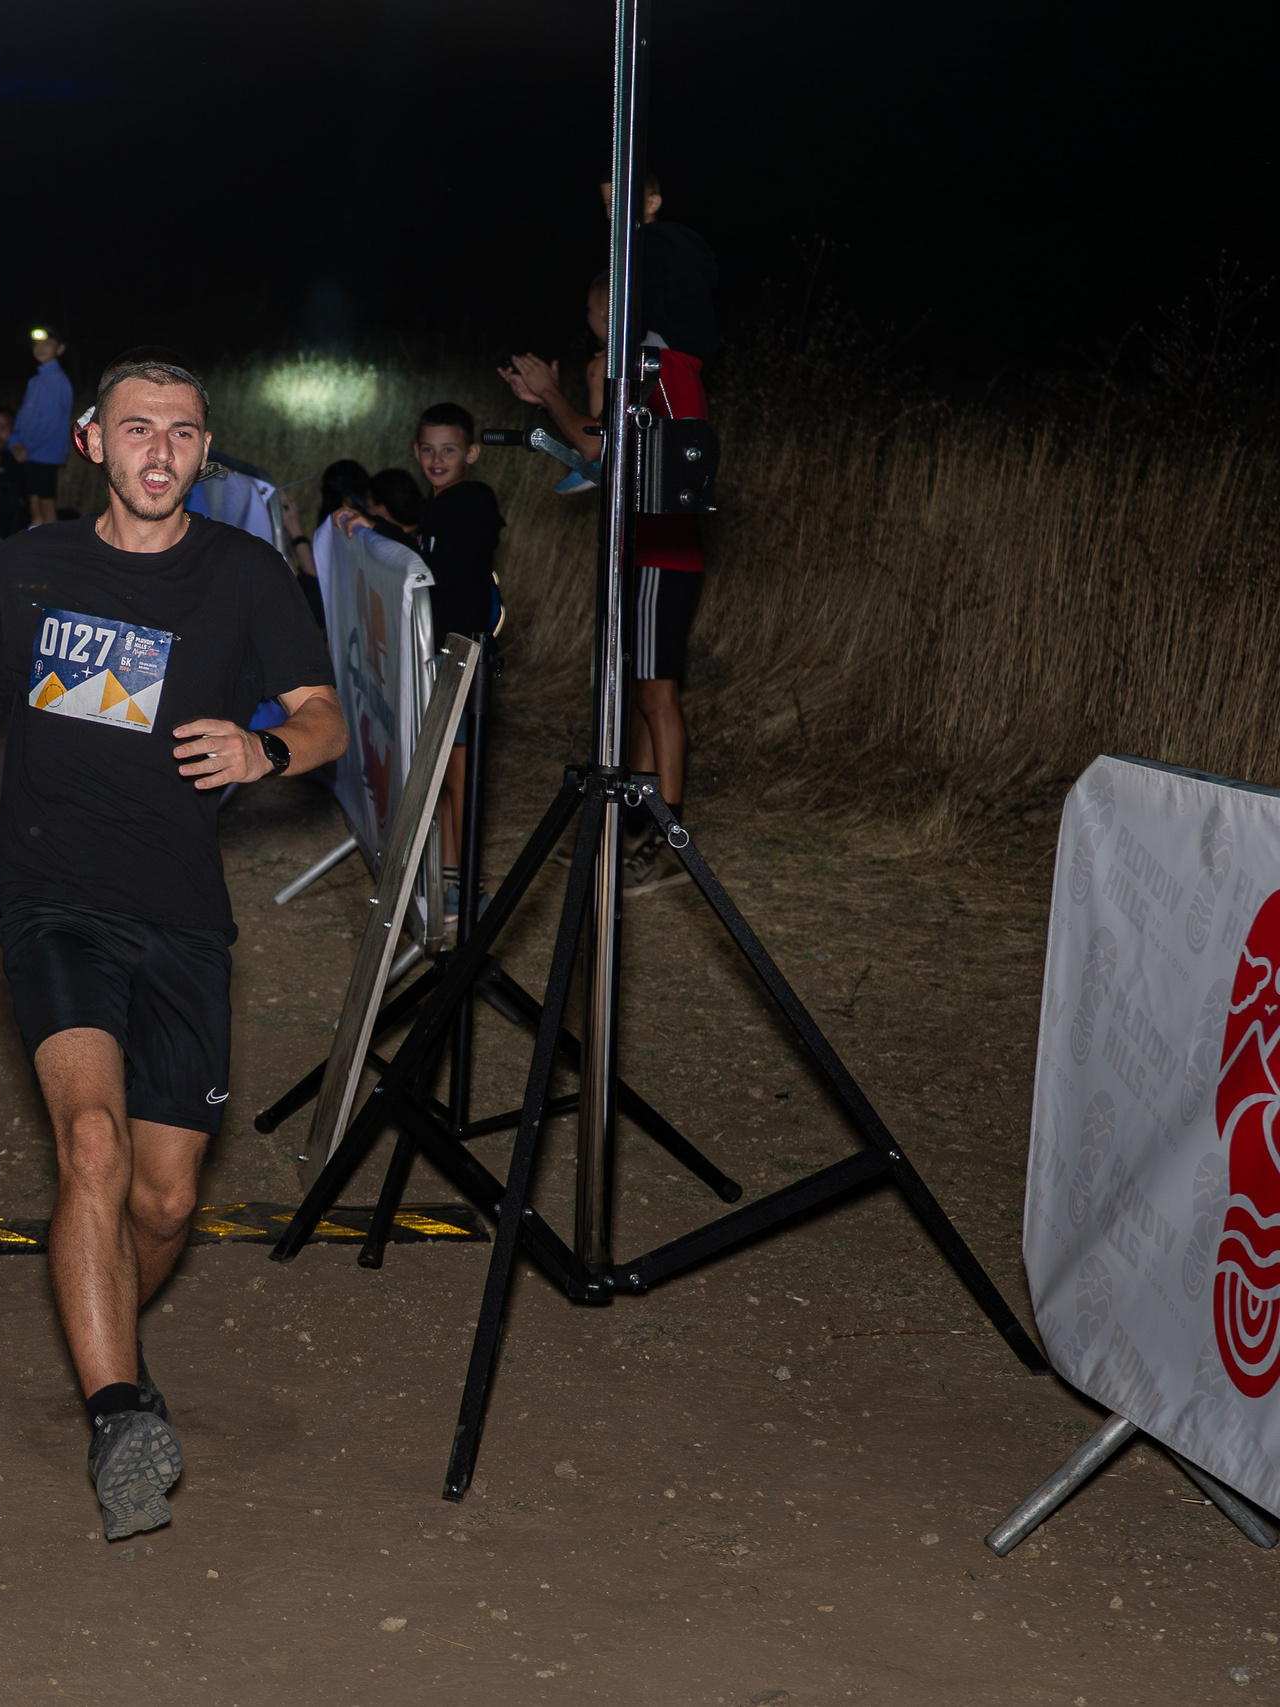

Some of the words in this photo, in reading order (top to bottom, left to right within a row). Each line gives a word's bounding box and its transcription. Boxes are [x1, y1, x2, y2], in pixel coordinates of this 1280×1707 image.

[39, 617, 117, 668] 0127
[120, 656, 132, 667] 6K
[1102, 862, 1150, 934] HILLS
[1115, 822, 1184, 916] PLOVDIV
[1101, 1024, 1147, 1101] HILLS
[1111, 985, 1180, 1085] PLOVDIV
[1095, 1187, 1142, 1270] HILLS
[1108, 1151, 1178, 1257] PLOVDIV
